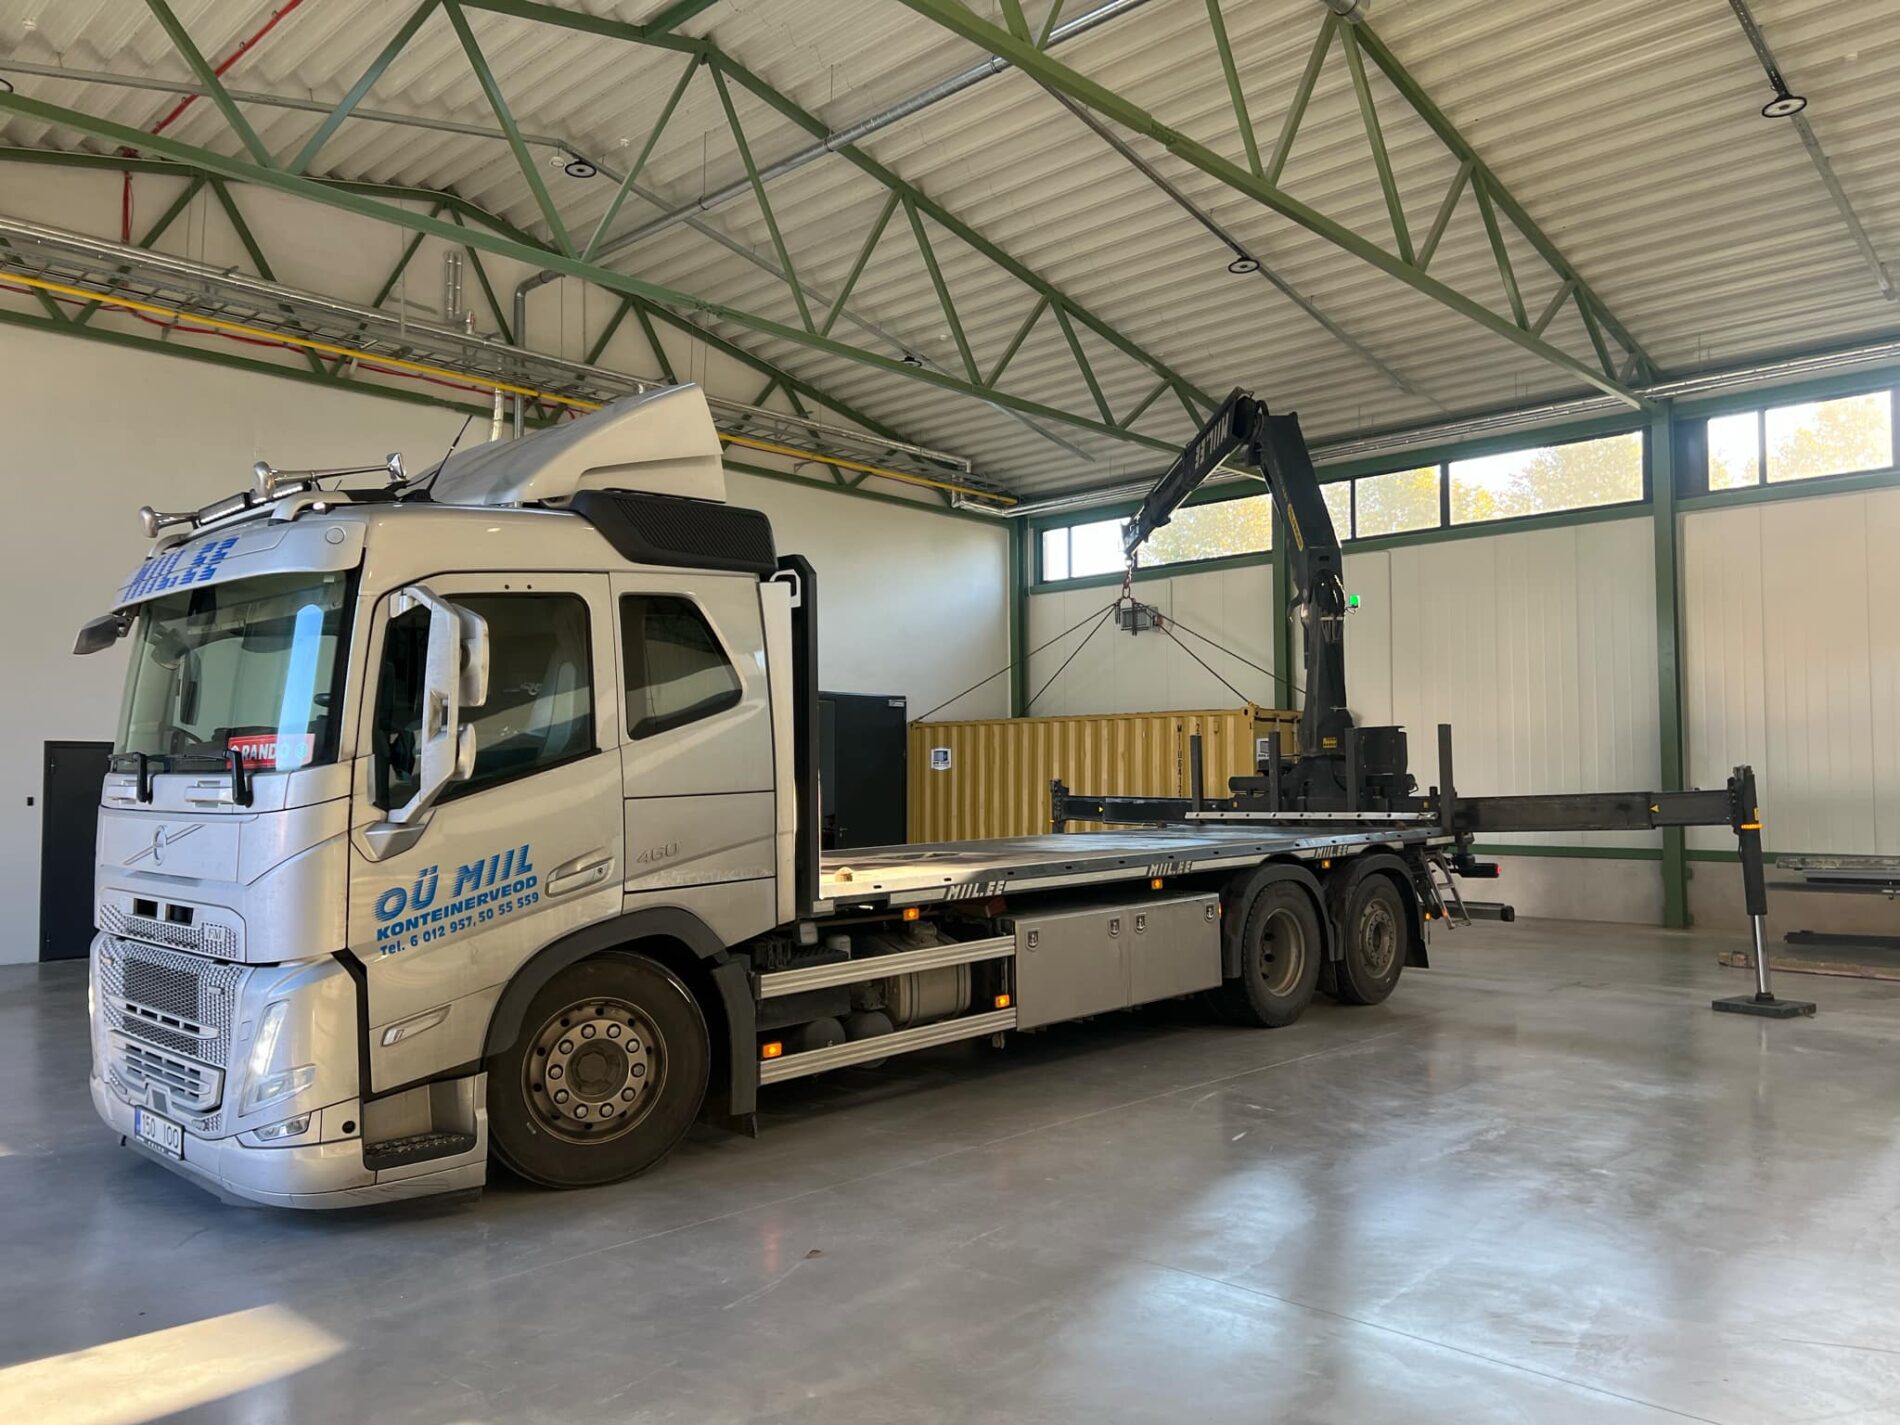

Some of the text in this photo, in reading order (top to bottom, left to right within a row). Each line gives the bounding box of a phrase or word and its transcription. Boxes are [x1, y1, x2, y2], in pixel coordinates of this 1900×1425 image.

[372, 844, 533, 922] OÜ MIIL
[945, 880, 1005, 901] MIIL.EE
[1148, 860, 1192, 877] MIIL.EE
[376, 875, 538, 942] KONTEINERVEOD
[379, 940, 406, 956] Tel.
[409, 934, 419, 947] 6
[422, 925, 446, 943] 012
[498, 901, 514, 915] 55
[517, 891, 540, 909] 559
